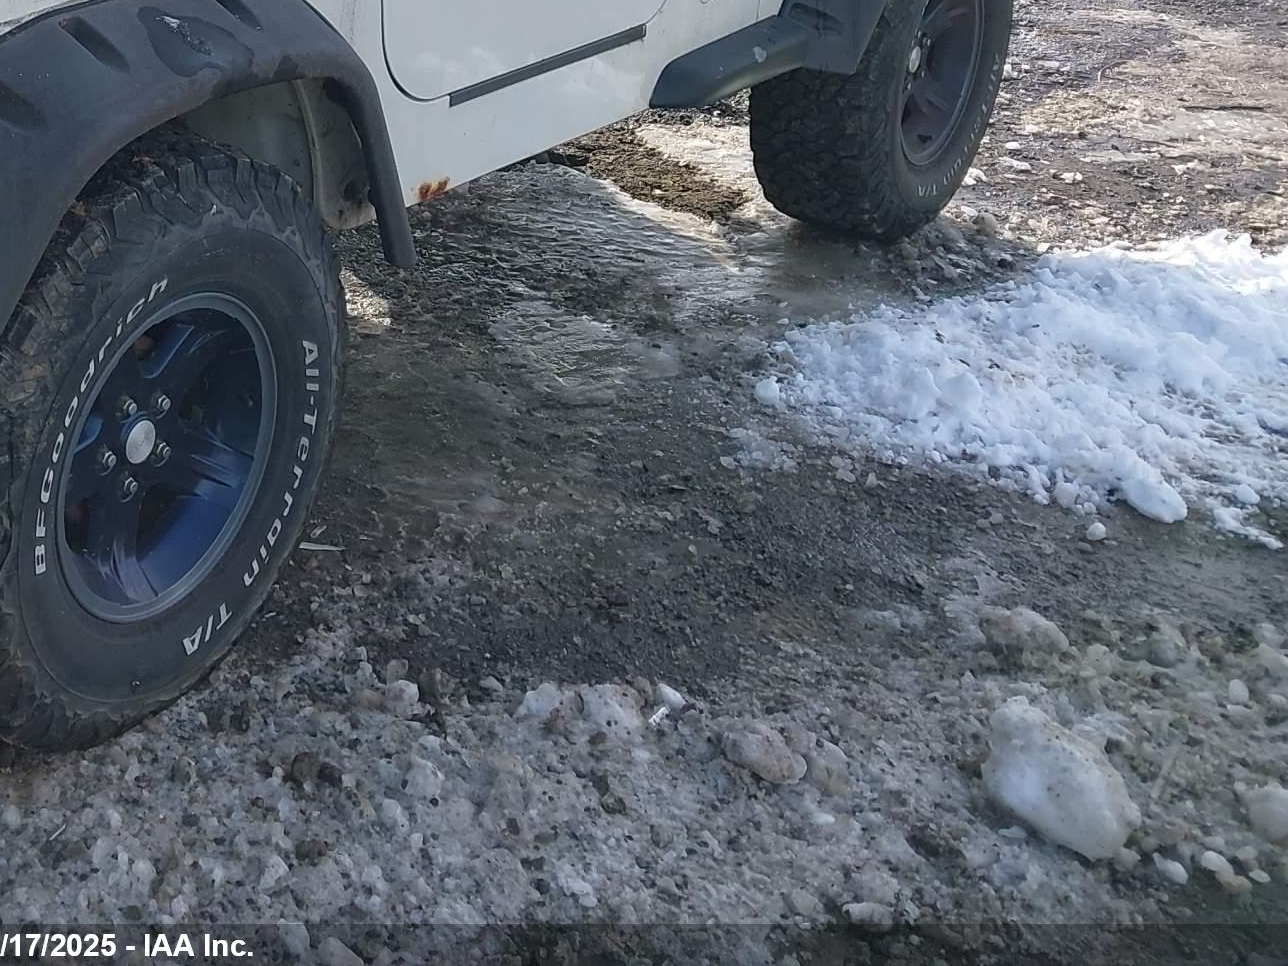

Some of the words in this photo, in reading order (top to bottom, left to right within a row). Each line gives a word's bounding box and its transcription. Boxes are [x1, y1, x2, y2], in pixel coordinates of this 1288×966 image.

[34, 274, 169, 575] BFGoodrich
[242, 339, 319, 587] All-Terrain
[179, 600, 233, 657] T/A
